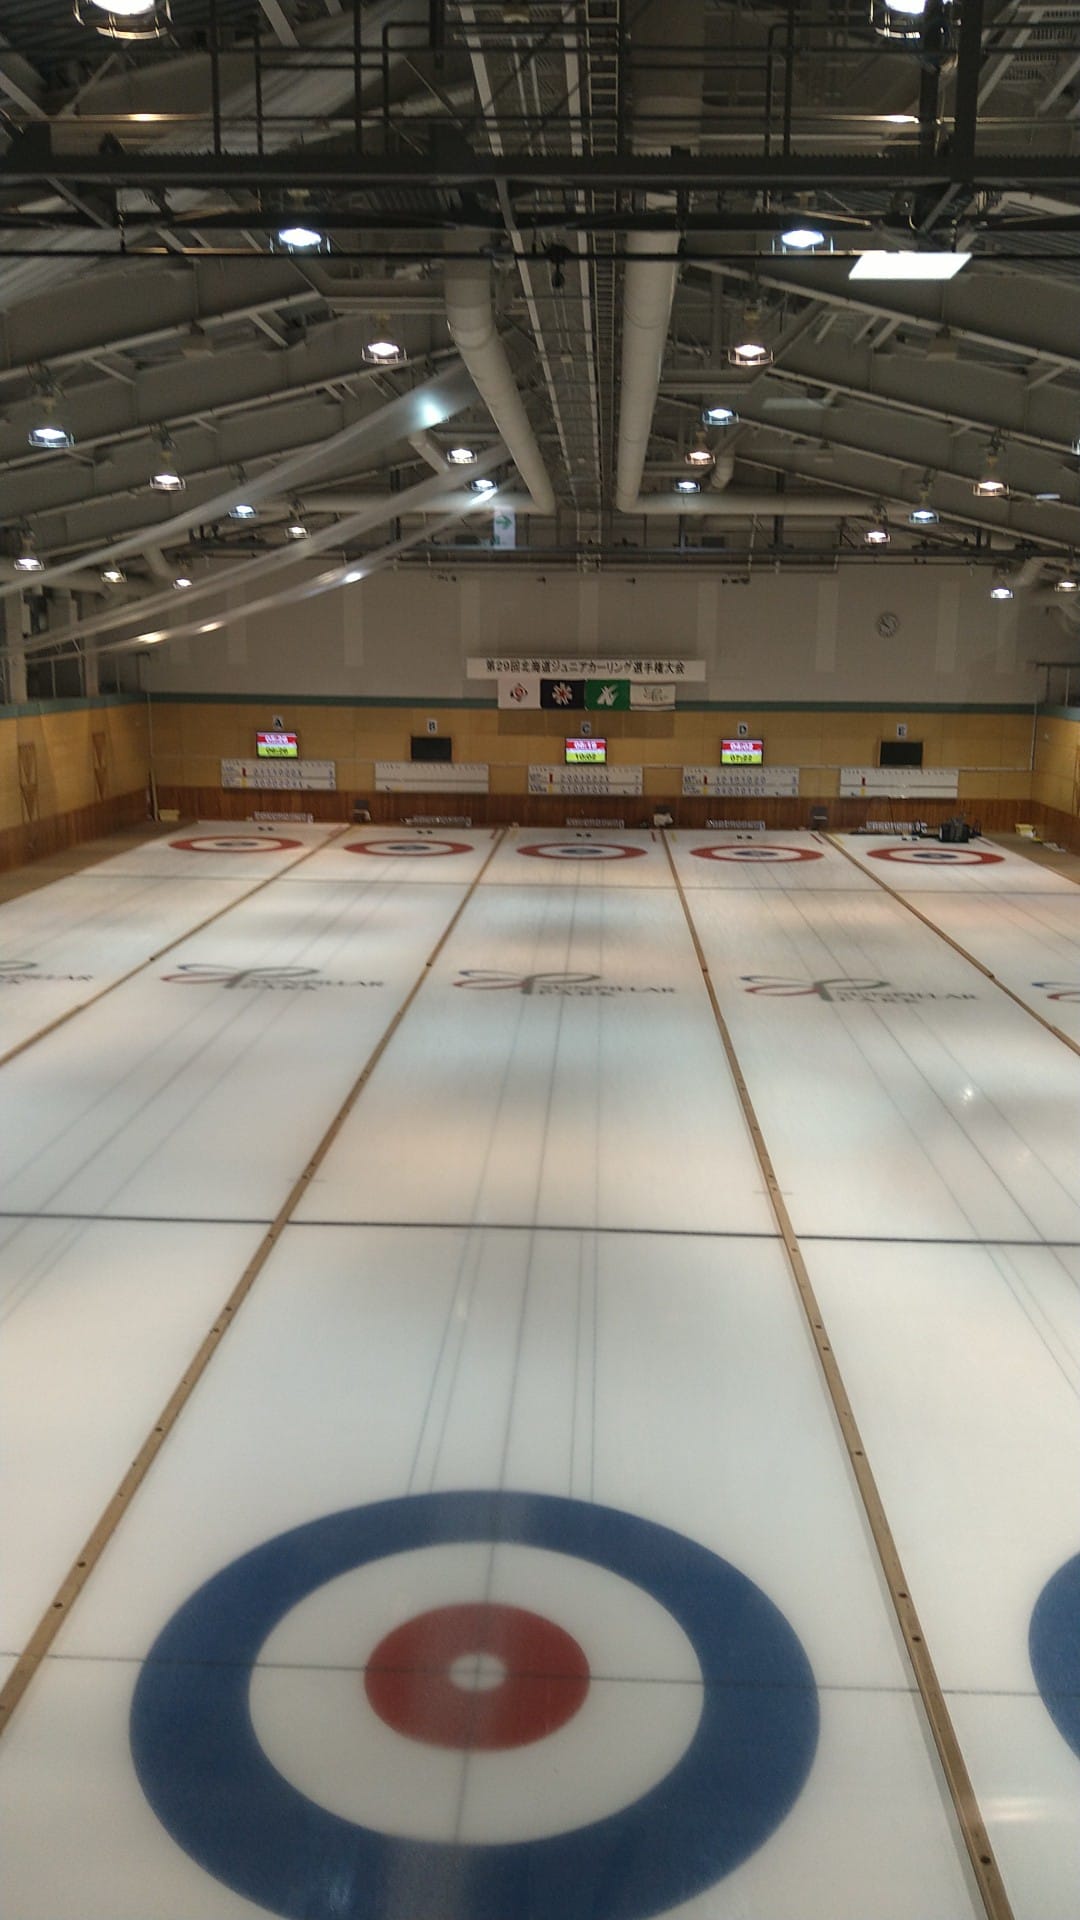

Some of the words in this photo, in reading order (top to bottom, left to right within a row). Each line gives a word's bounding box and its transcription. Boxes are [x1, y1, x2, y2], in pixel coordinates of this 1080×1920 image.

[487, 659, 685, 674] 第29回北海道ジュニアカーリング選手権大会
